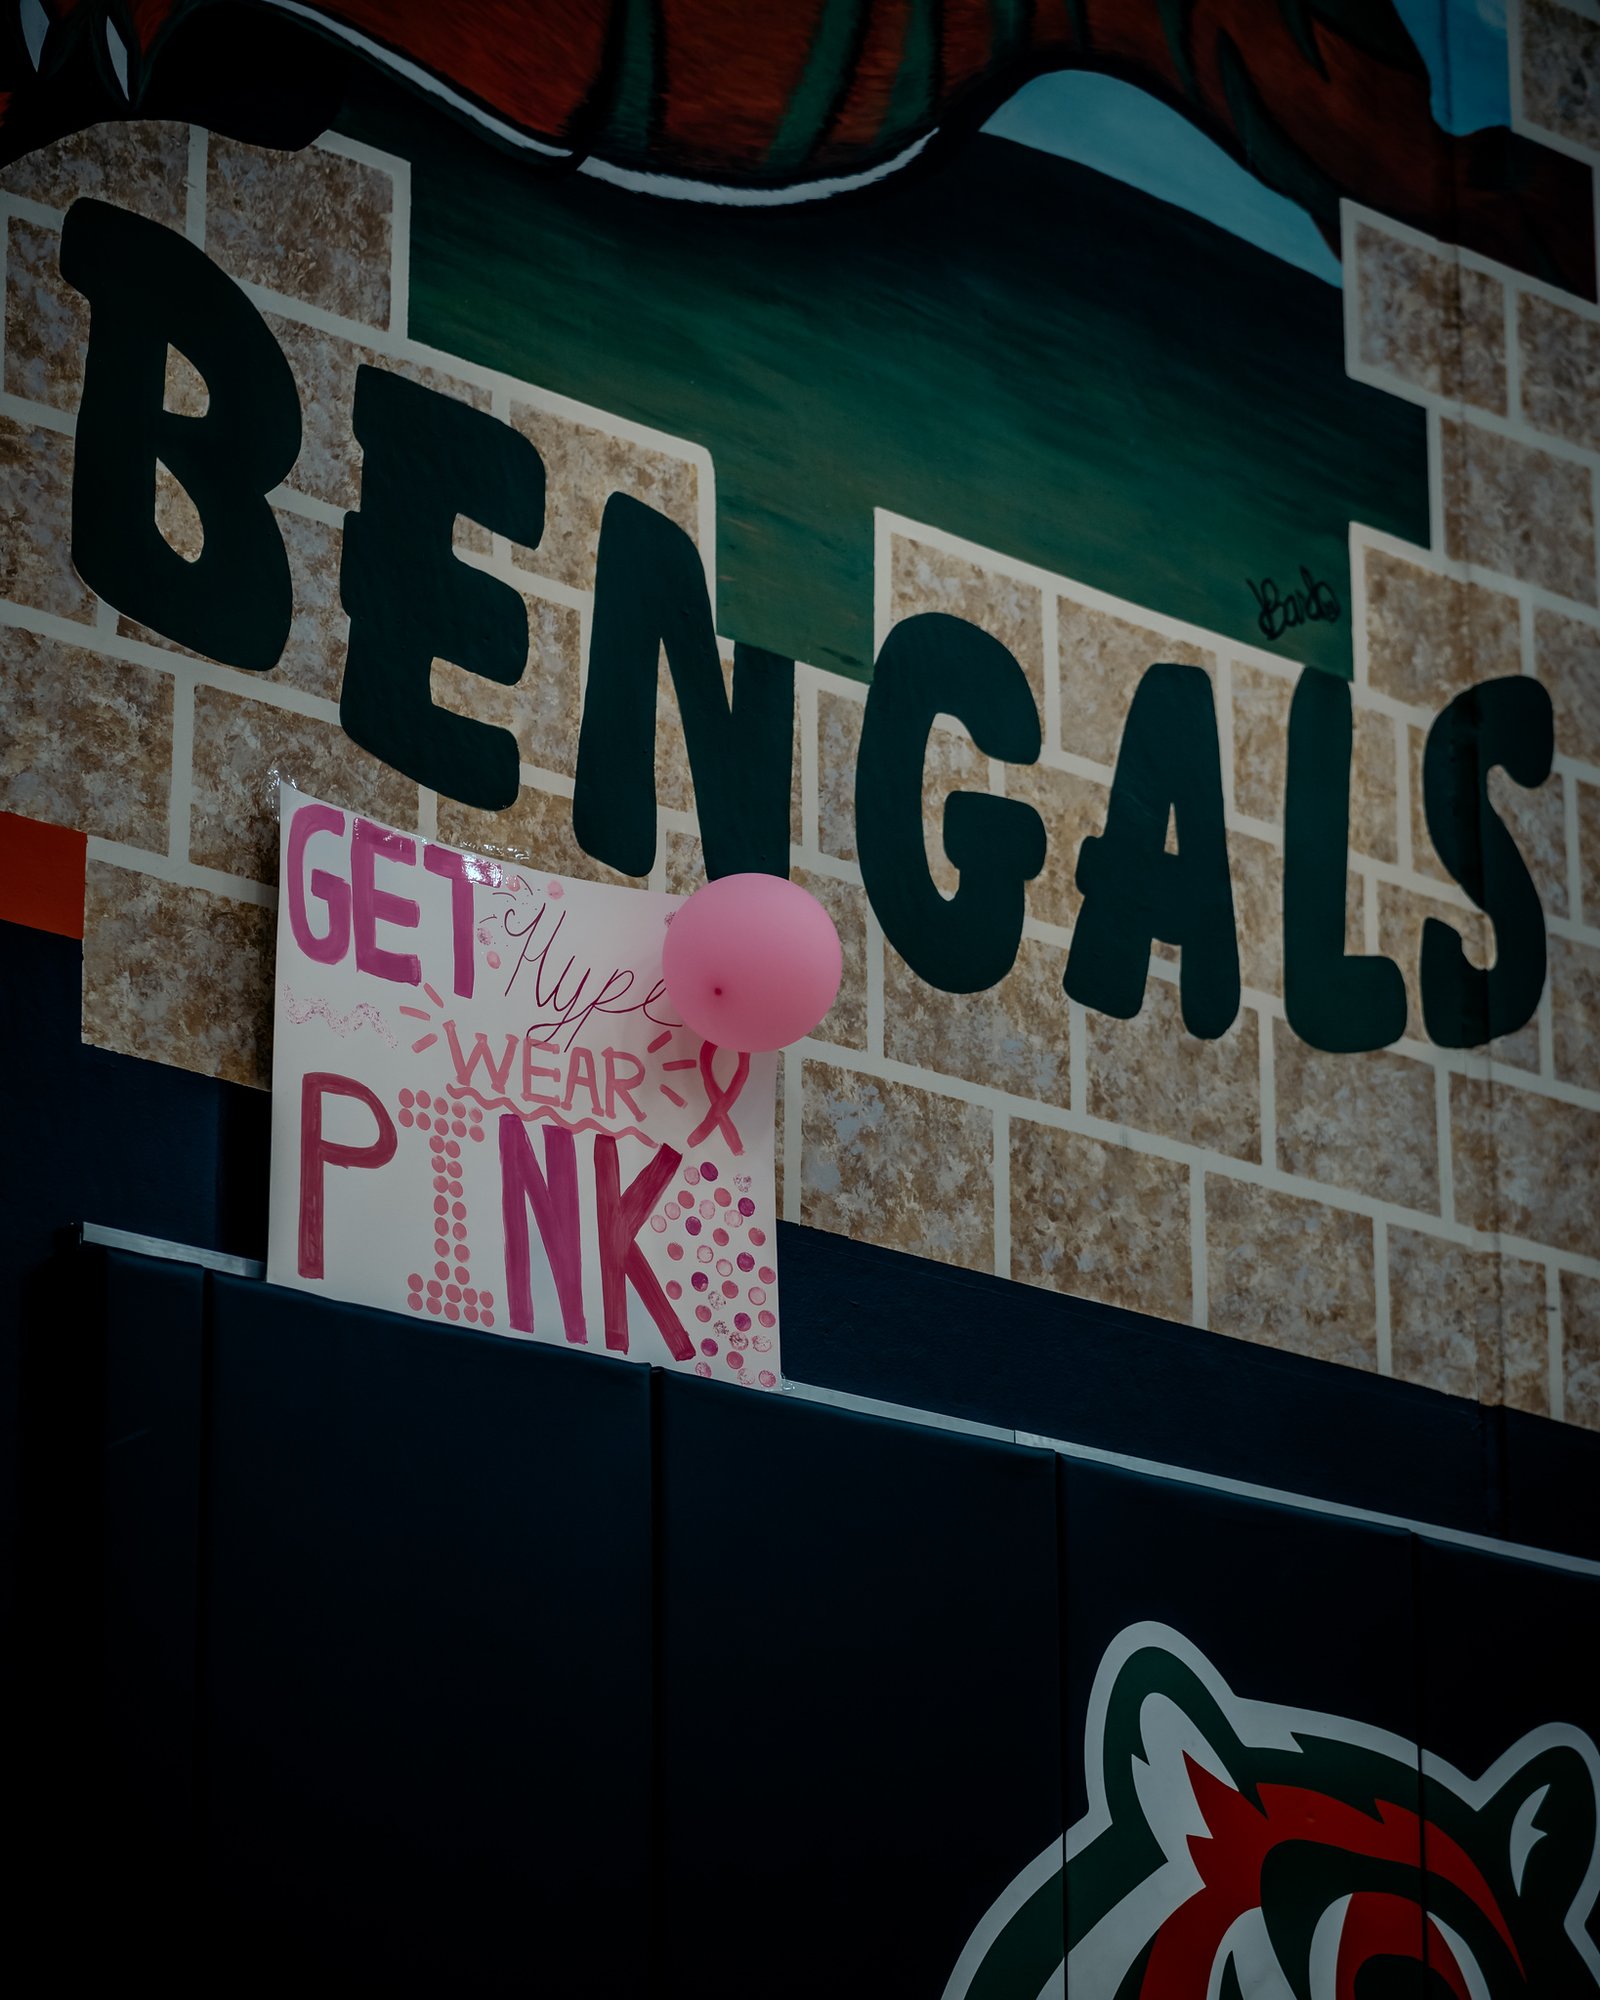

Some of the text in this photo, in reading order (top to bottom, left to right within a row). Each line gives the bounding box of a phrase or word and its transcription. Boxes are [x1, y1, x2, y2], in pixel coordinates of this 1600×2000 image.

[60, 197, 1554, 1053] BENGALS
[287, 804, 683, 1054] GET Hype
[443, 1020, 647, 1122] WEAR
[297, 1072, 696, 1362] PINK
